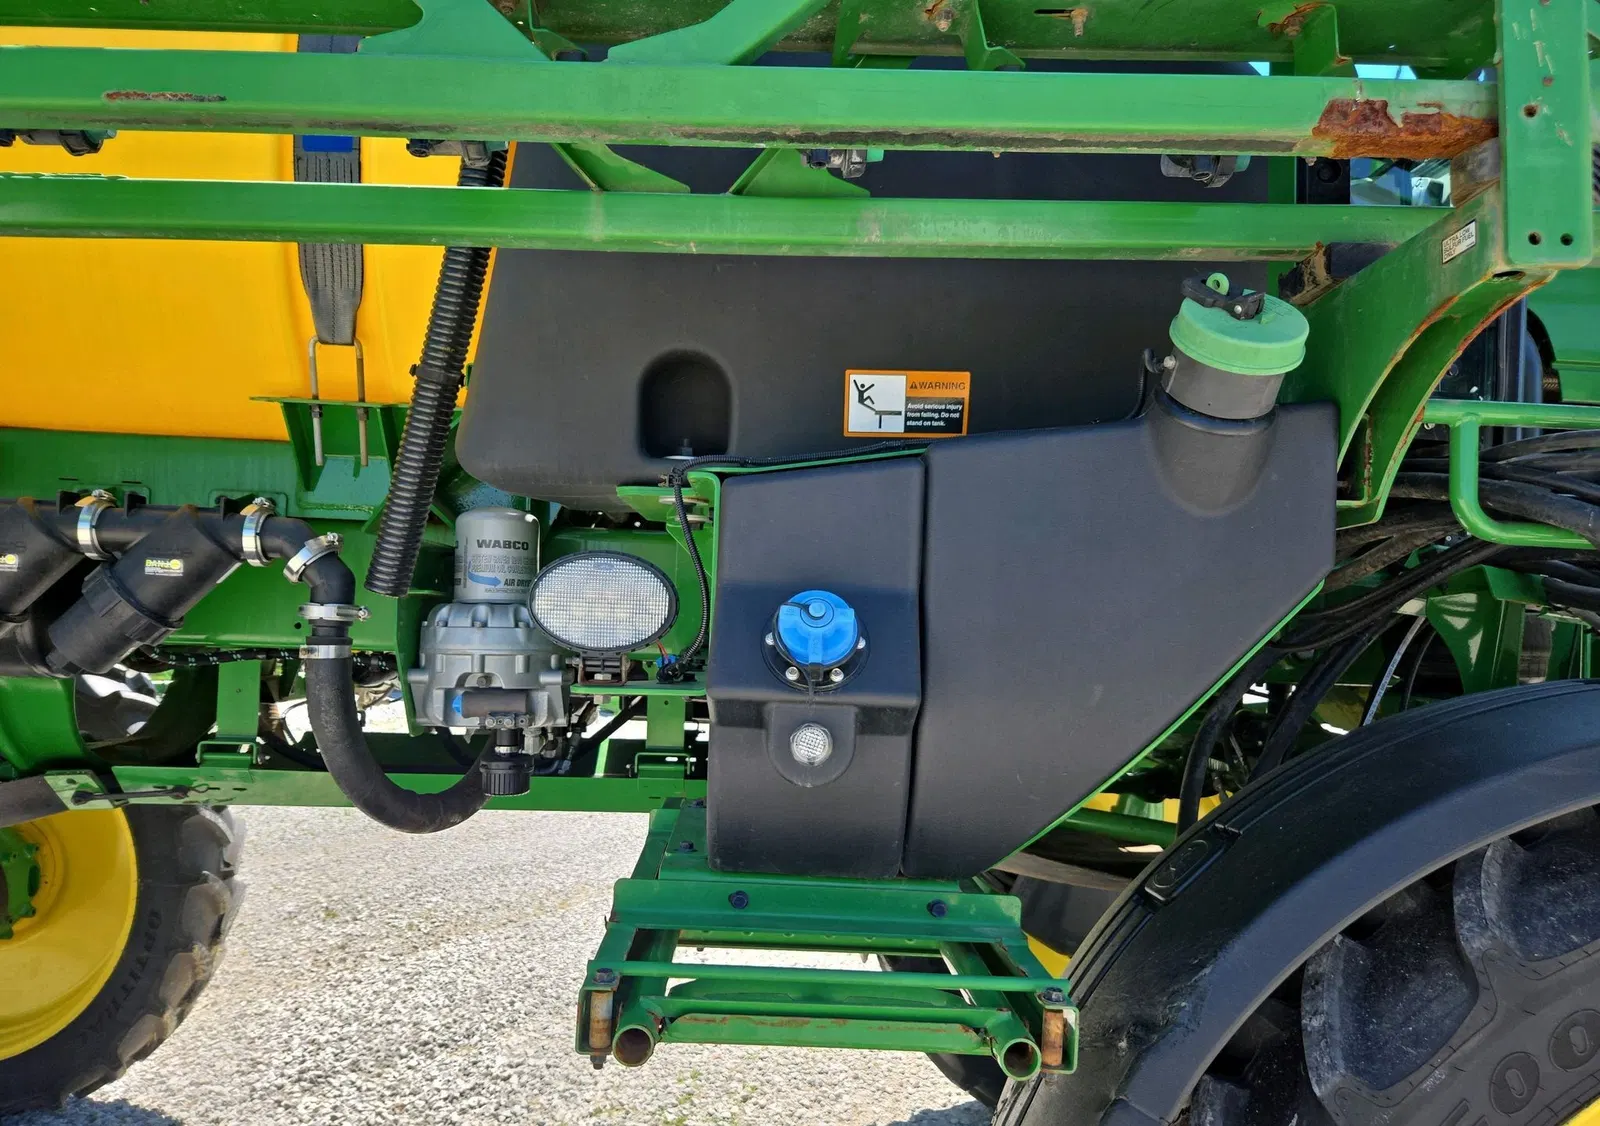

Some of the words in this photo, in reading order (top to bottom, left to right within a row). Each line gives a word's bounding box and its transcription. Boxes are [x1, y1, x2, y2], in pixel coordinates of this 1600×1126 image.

[919, 381, 966, 391] WARNING
[924, 403, 945, 411] serious
[946, 403, 963, 412] injury
[921, 411, 940, 419] falling.
[476, 539, 529, 551] WABCO
[504, 578, 516, 587] AIR
[516, 578, 531, 588] DRYE
